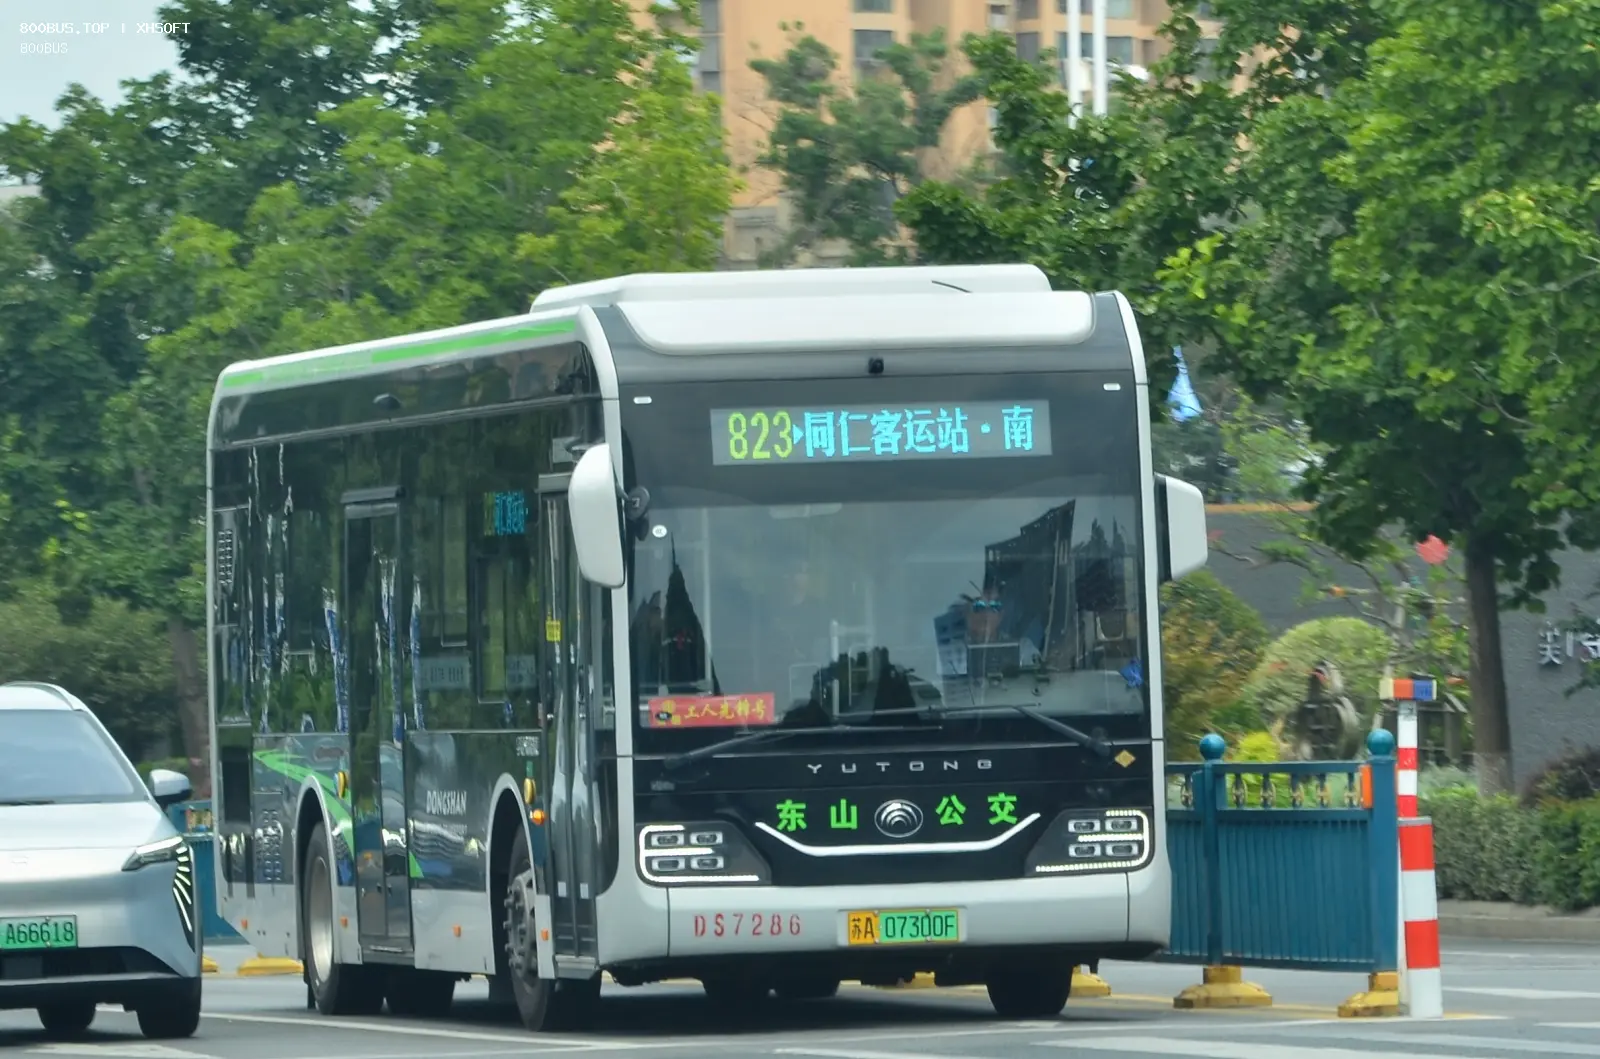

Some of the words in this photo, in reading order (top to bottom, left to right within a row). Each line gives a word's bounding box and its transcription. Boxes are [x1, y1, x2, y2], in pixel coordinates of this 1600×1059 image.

[728, 411, 793, 459] 823
[807, 759, 992, 774] YUTONG
[426, 790, 467, 816] DONGSHAN
[776, 798, 858, 832] 东山
[935, 792, 1018, 826] 公交
[6, 921, 75, 944] A66618
[694, 912, 801, 937] DS7286
[885, 914, 956, 938] 07300F
